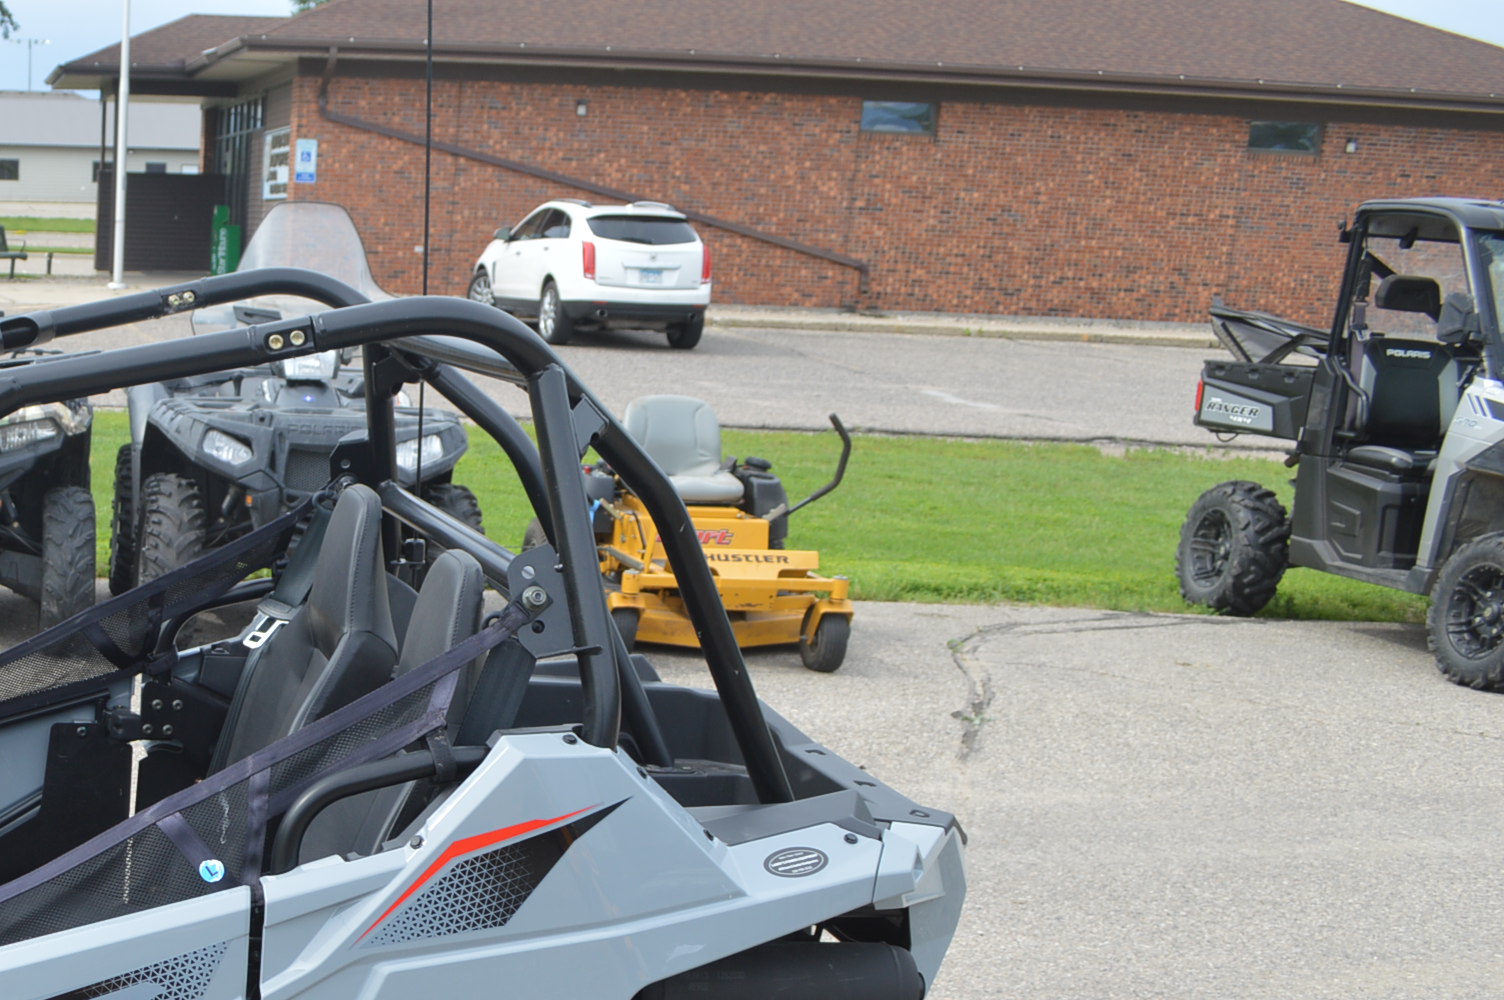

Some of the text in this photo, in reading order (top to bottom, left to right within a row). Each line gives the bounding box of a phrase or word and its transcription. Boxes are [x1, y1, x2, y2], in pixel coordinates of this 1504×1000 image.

[1386, 348, 1432, 359] POLARIS
[1205, 401, 1261, 417] RANGER
[706, 553, 790, 564] HUSTLER
